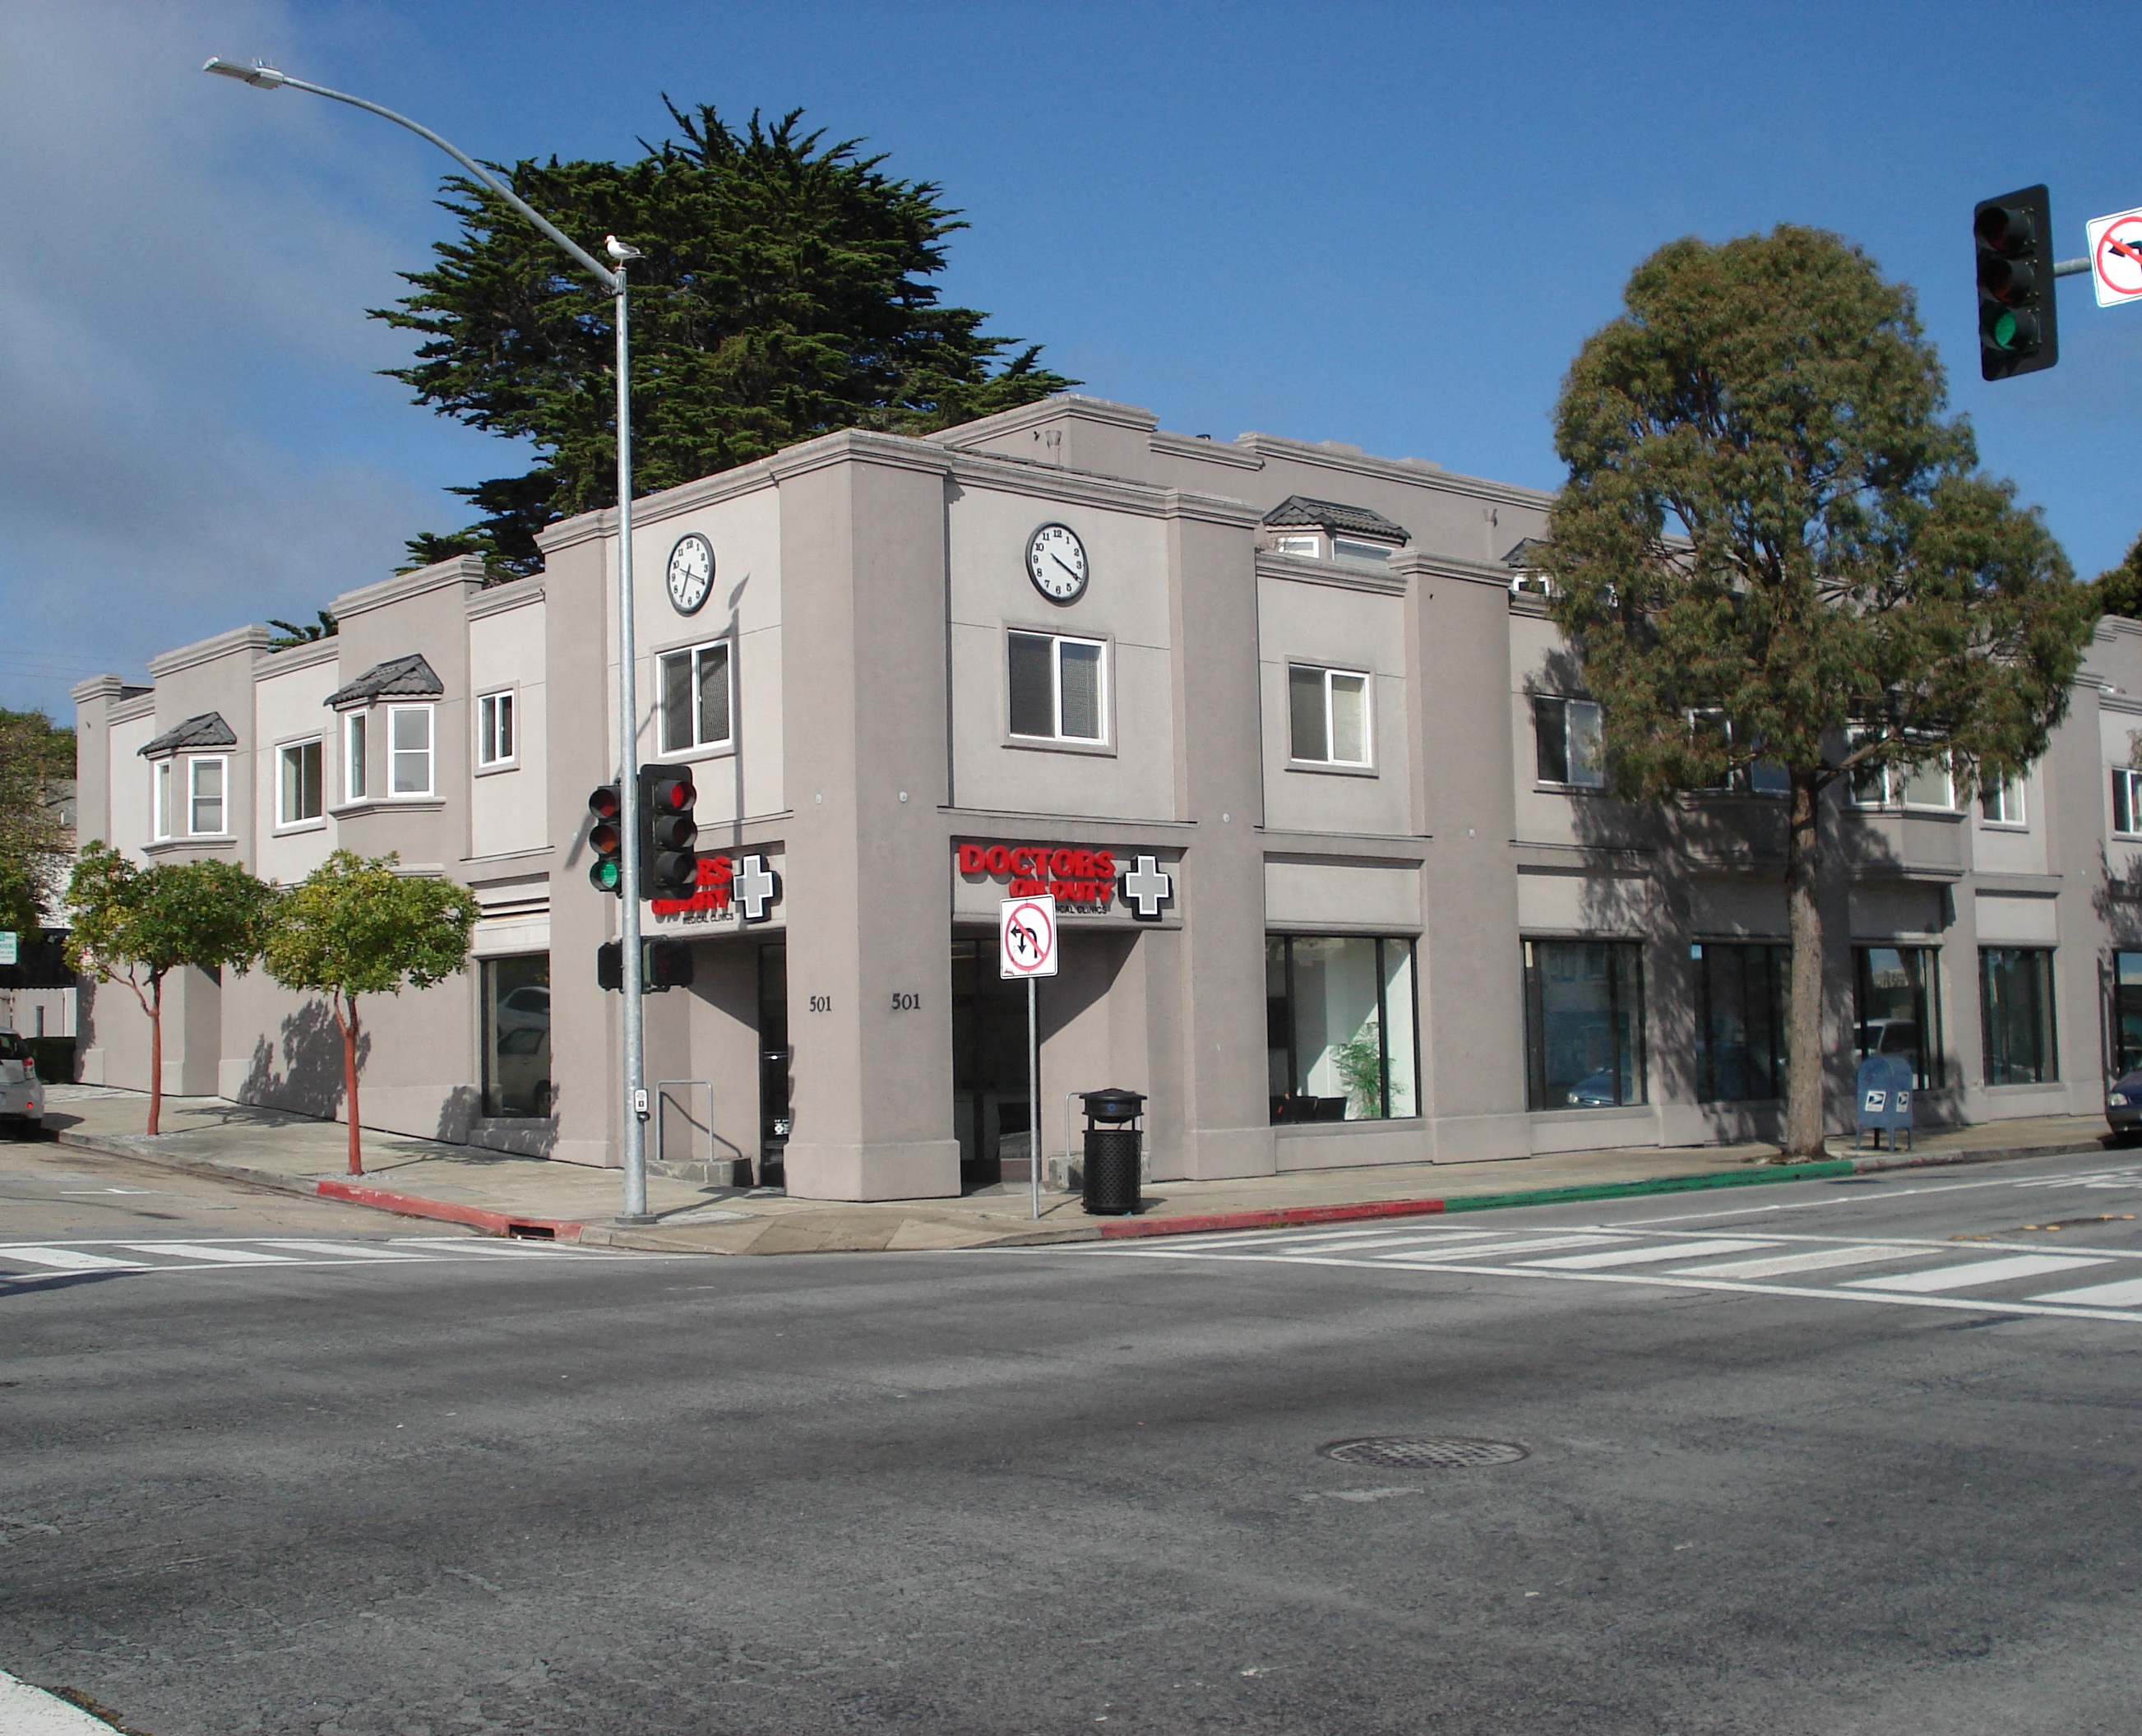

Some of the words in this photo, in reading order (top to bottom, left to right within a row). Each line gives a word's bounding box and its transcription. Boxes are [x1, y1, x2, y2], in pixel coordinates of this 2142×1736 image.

[1043, 532, 1050, 541] 11
[1053, 530, 1062, 538] 12
[686, 539, 693, 549] 12
[1066, 536, 1070, 544] 1
[696, 543, 700, 551] 1
[1035, 543, 1044, 551] 10
[678, 549, 683, 557] 11
[701, 553, 706, 561] 2
[1074, 549, 1079, 557] 2
[1033, 555, 1039, 563] 9
[673, 560, 679, 570] 10
[703, 564, 708, 573] 3
[1076, 561, 1082, 569] 3
[1037, 568, 1043, 576] 8
[671, 573, 676, 582] 9
[1044, 580, 1050, 588] 7
[1066, 583, 1071, 591] 5
[673, 585, 678, 594] 8
[1056, 586, 1061, 595] 6
[696, 590, 701, 599] 5
[687, 596, 692, 605] 6
[959, 844, 1116, 878] DOCTORS
[1009, 878, 1047, 899] ON
[1049, 881, 1114, 902] DUTY
[1076, 906, 1107, 914] CLINICS
[710, 913, 734, 922] CLINICS
[809, 996, 831, 1012] 501
[892, 993, 920, 1010] 501
